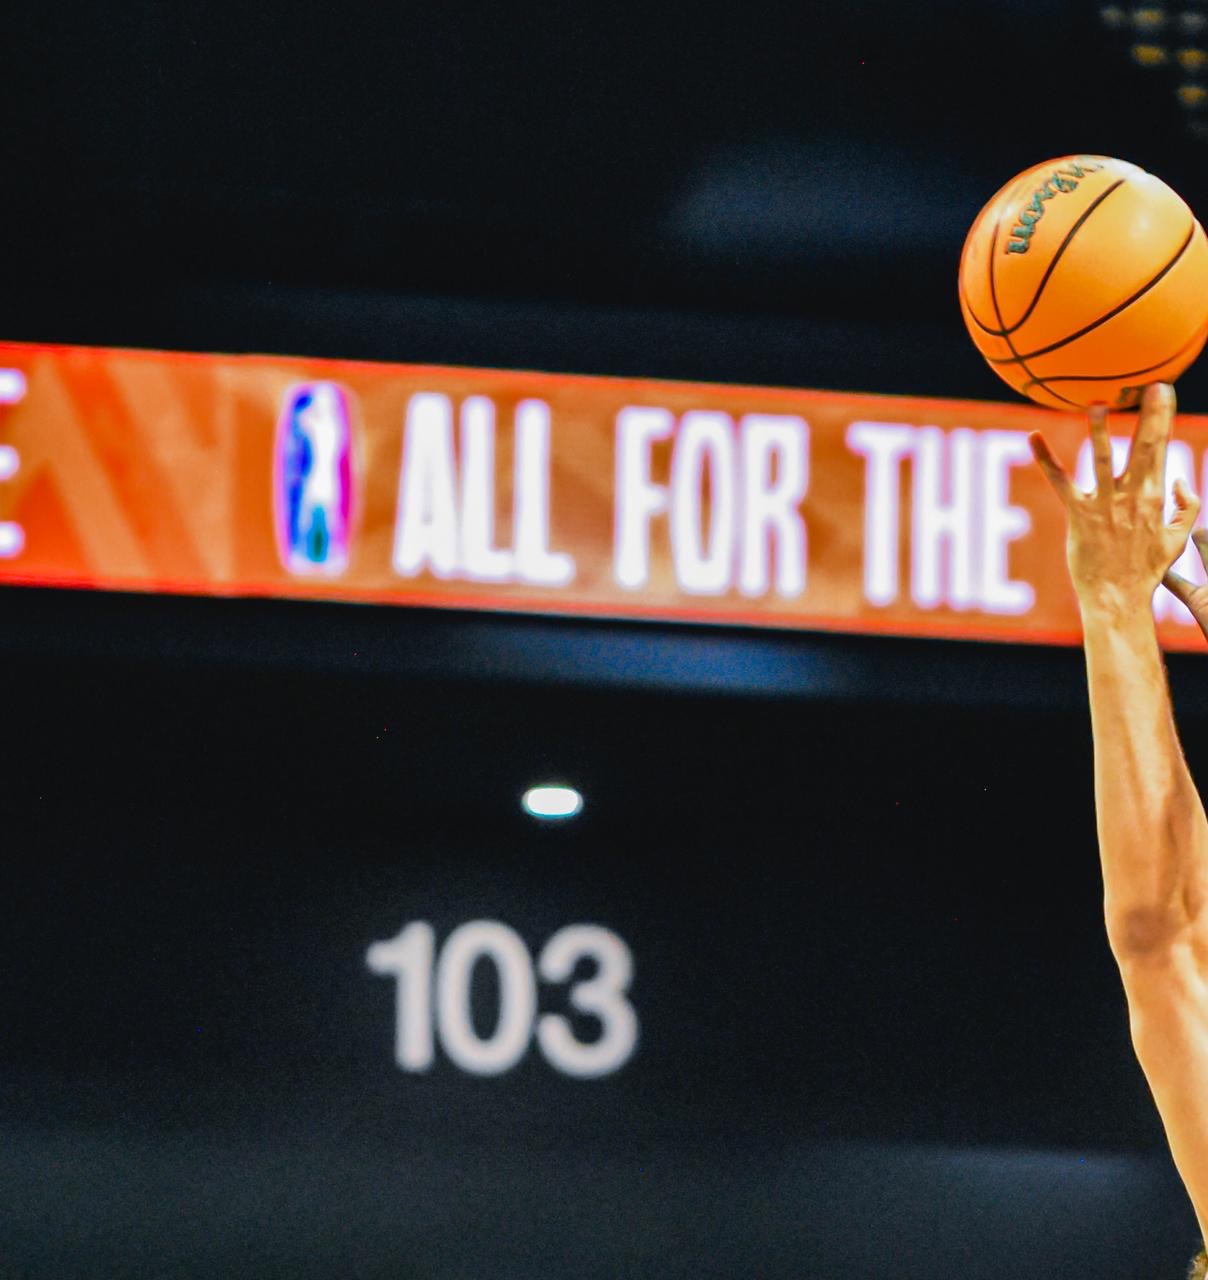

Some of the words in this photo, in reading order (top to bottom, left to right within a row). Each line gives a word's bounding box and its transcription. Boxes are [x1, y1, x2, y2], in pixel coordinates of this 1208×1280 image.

[394, 392, 574, 586] ALL
[613, 406, 807, 600] FOR
[847, 420, 1036, 614] THE
[366, 919, 638, 1078] 103
